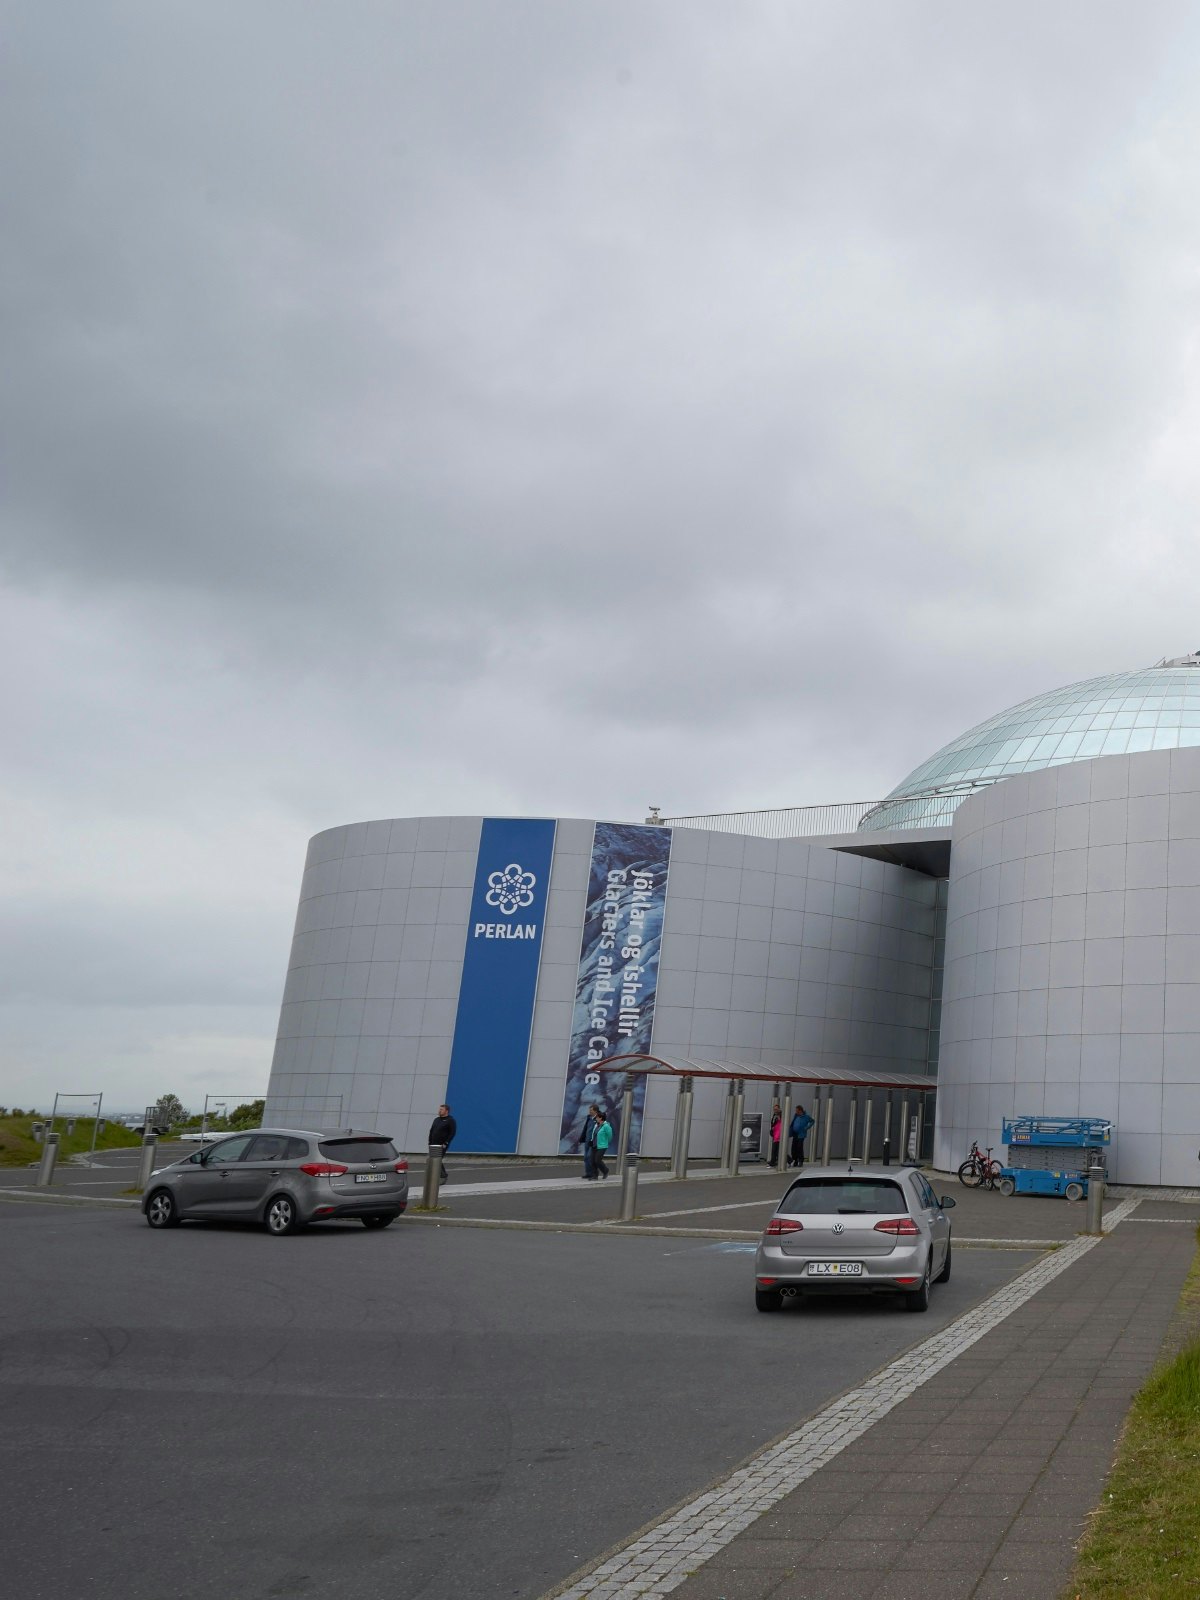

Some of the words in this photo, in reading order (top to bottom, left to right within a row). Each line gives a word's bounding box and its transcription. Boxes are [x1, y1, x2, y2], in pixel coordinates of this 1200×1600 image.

[600, 869, 627, 949] Glaciers
[629, 869, 654, 929] Jöklar
[474, 923, 537, 939] PERLAN
[621, 934, 643, 959] og
[595, 955, 616, 992] and
[591, 998, 613, 1029] Ice
[617, 965, 645, 1037] íshellir
[816, 1264, 831, 1273] LX
[839, 1264, 860, 1273] E08
